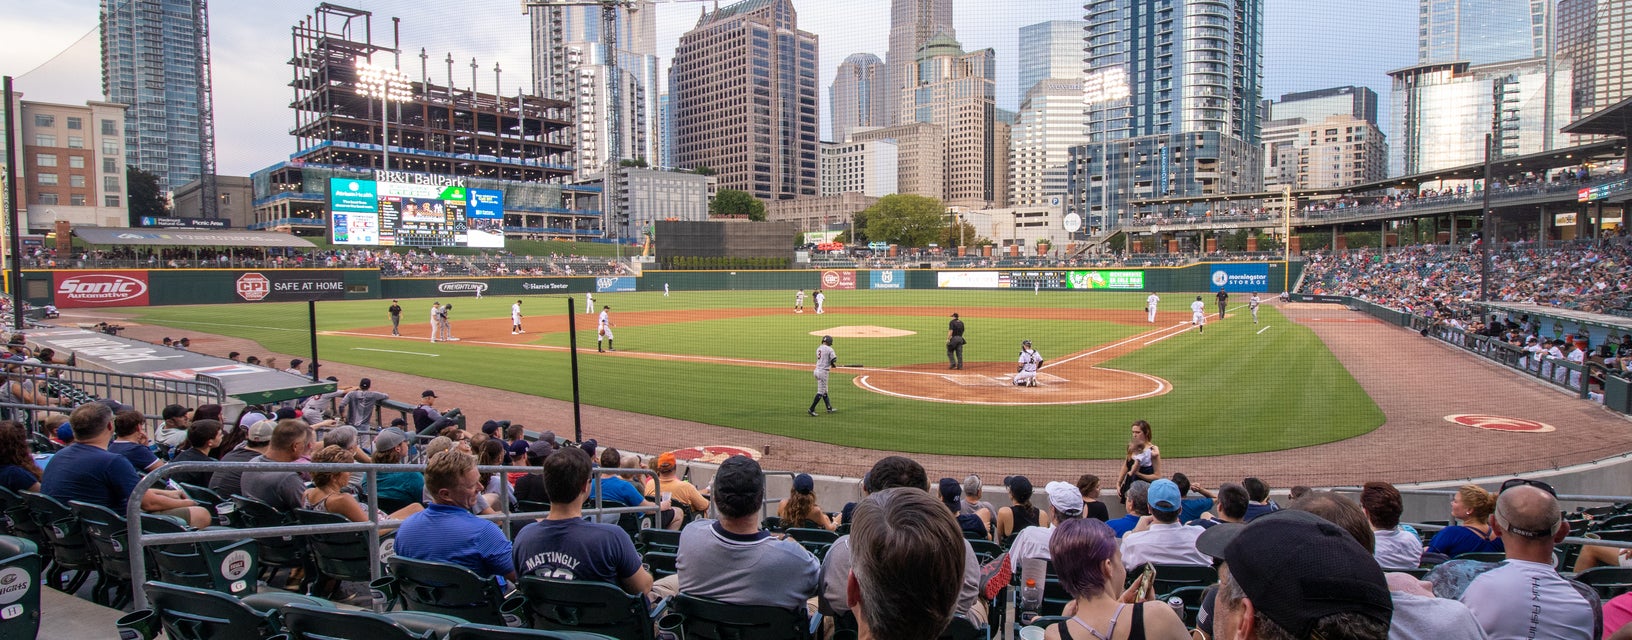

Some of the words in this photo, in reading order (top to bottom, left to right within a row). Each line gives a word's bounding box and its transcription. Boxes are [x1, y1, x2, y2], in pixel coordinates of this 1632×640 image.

[375, 169, 412, 184] BB&T
[414, 173, 465, 188] BallPark
[57, 279, 136, 294] Sonic
[240, 282, 267, 291] CPI
[274, 282, 300, 291] SAFE
[302, 282, 313, 290] AT
[316, 281, 344, 290] HOME
[525, 551, 581, 571] MATTINGLY
[8, 606, 17, 616] H
